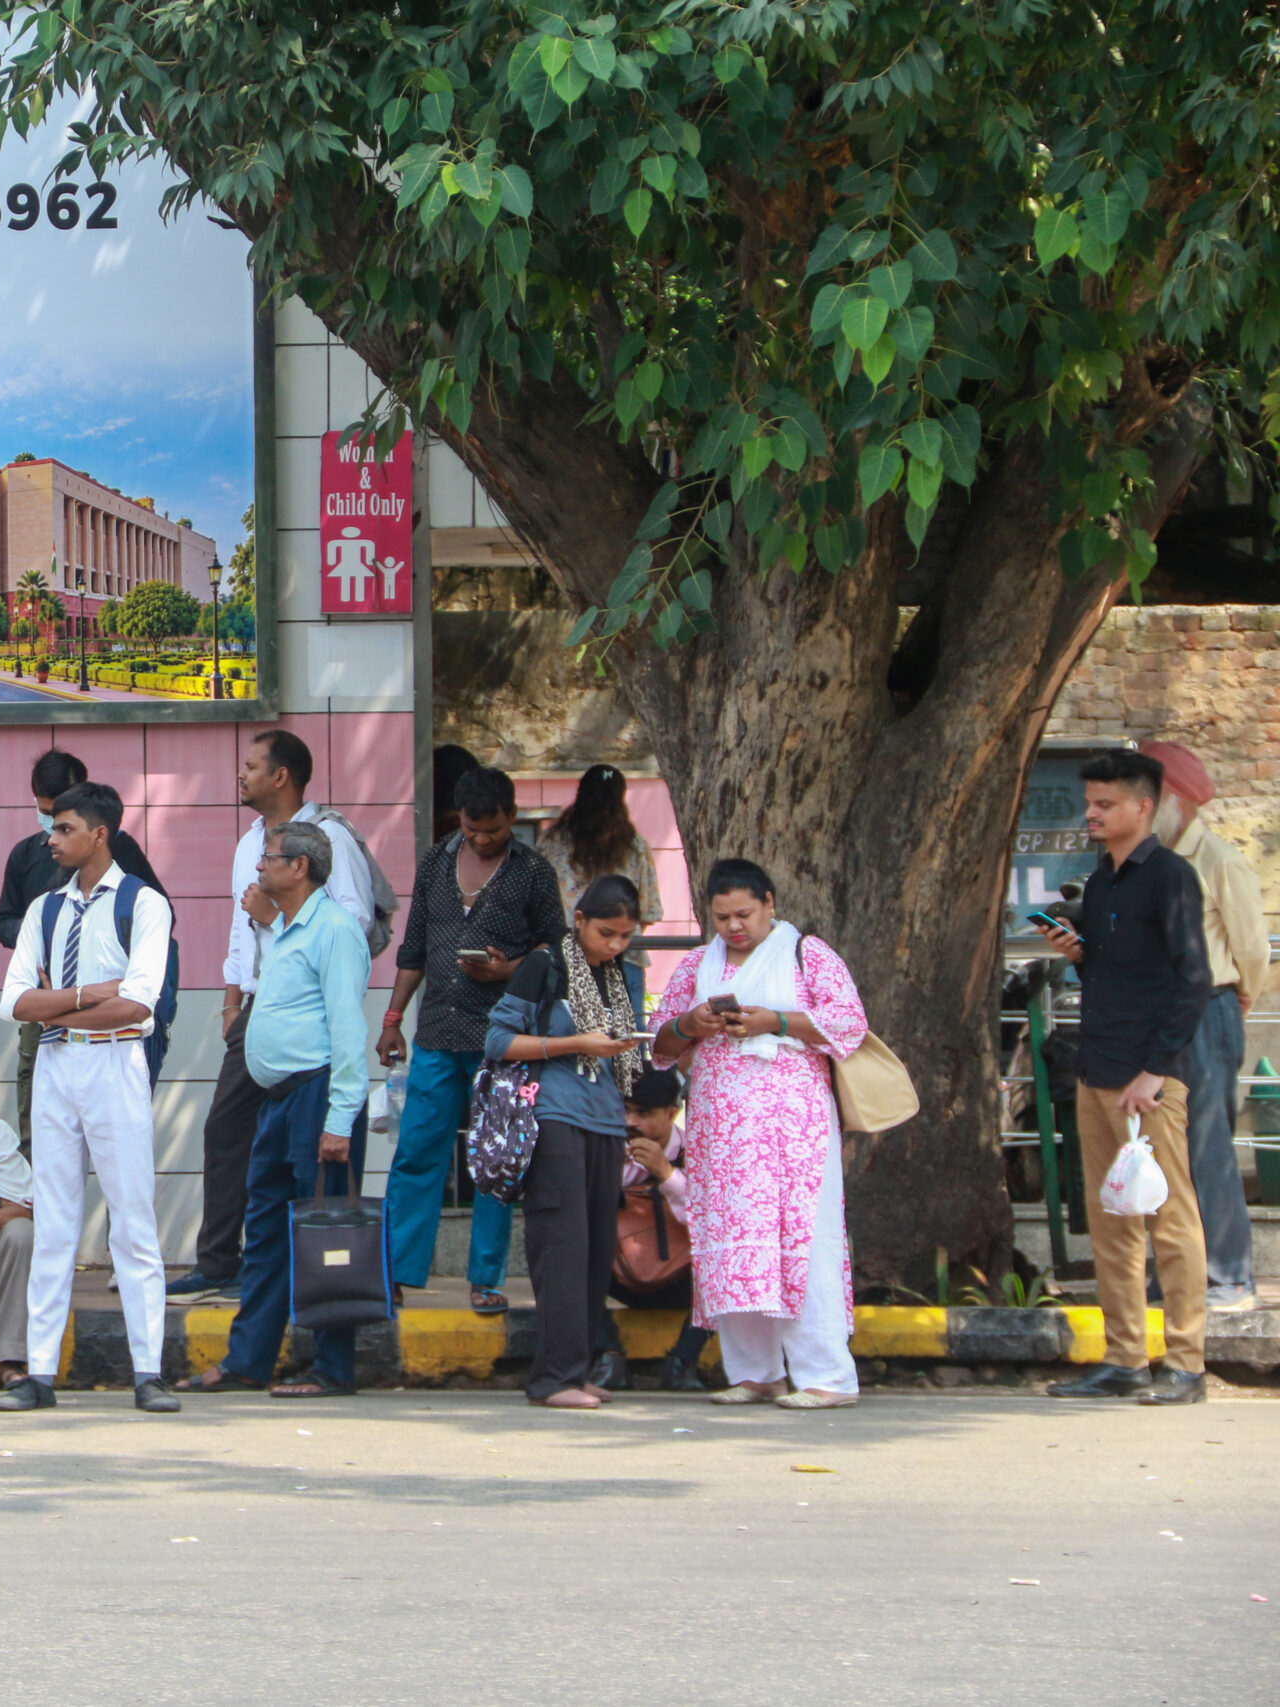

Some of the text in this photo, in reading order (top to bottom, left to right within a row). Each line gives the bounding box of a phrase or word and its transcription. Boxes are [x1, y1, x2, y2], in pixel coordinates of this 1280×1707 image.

[360, 466, 371, 489] &
[326, 492, 405, 522] Child Only
